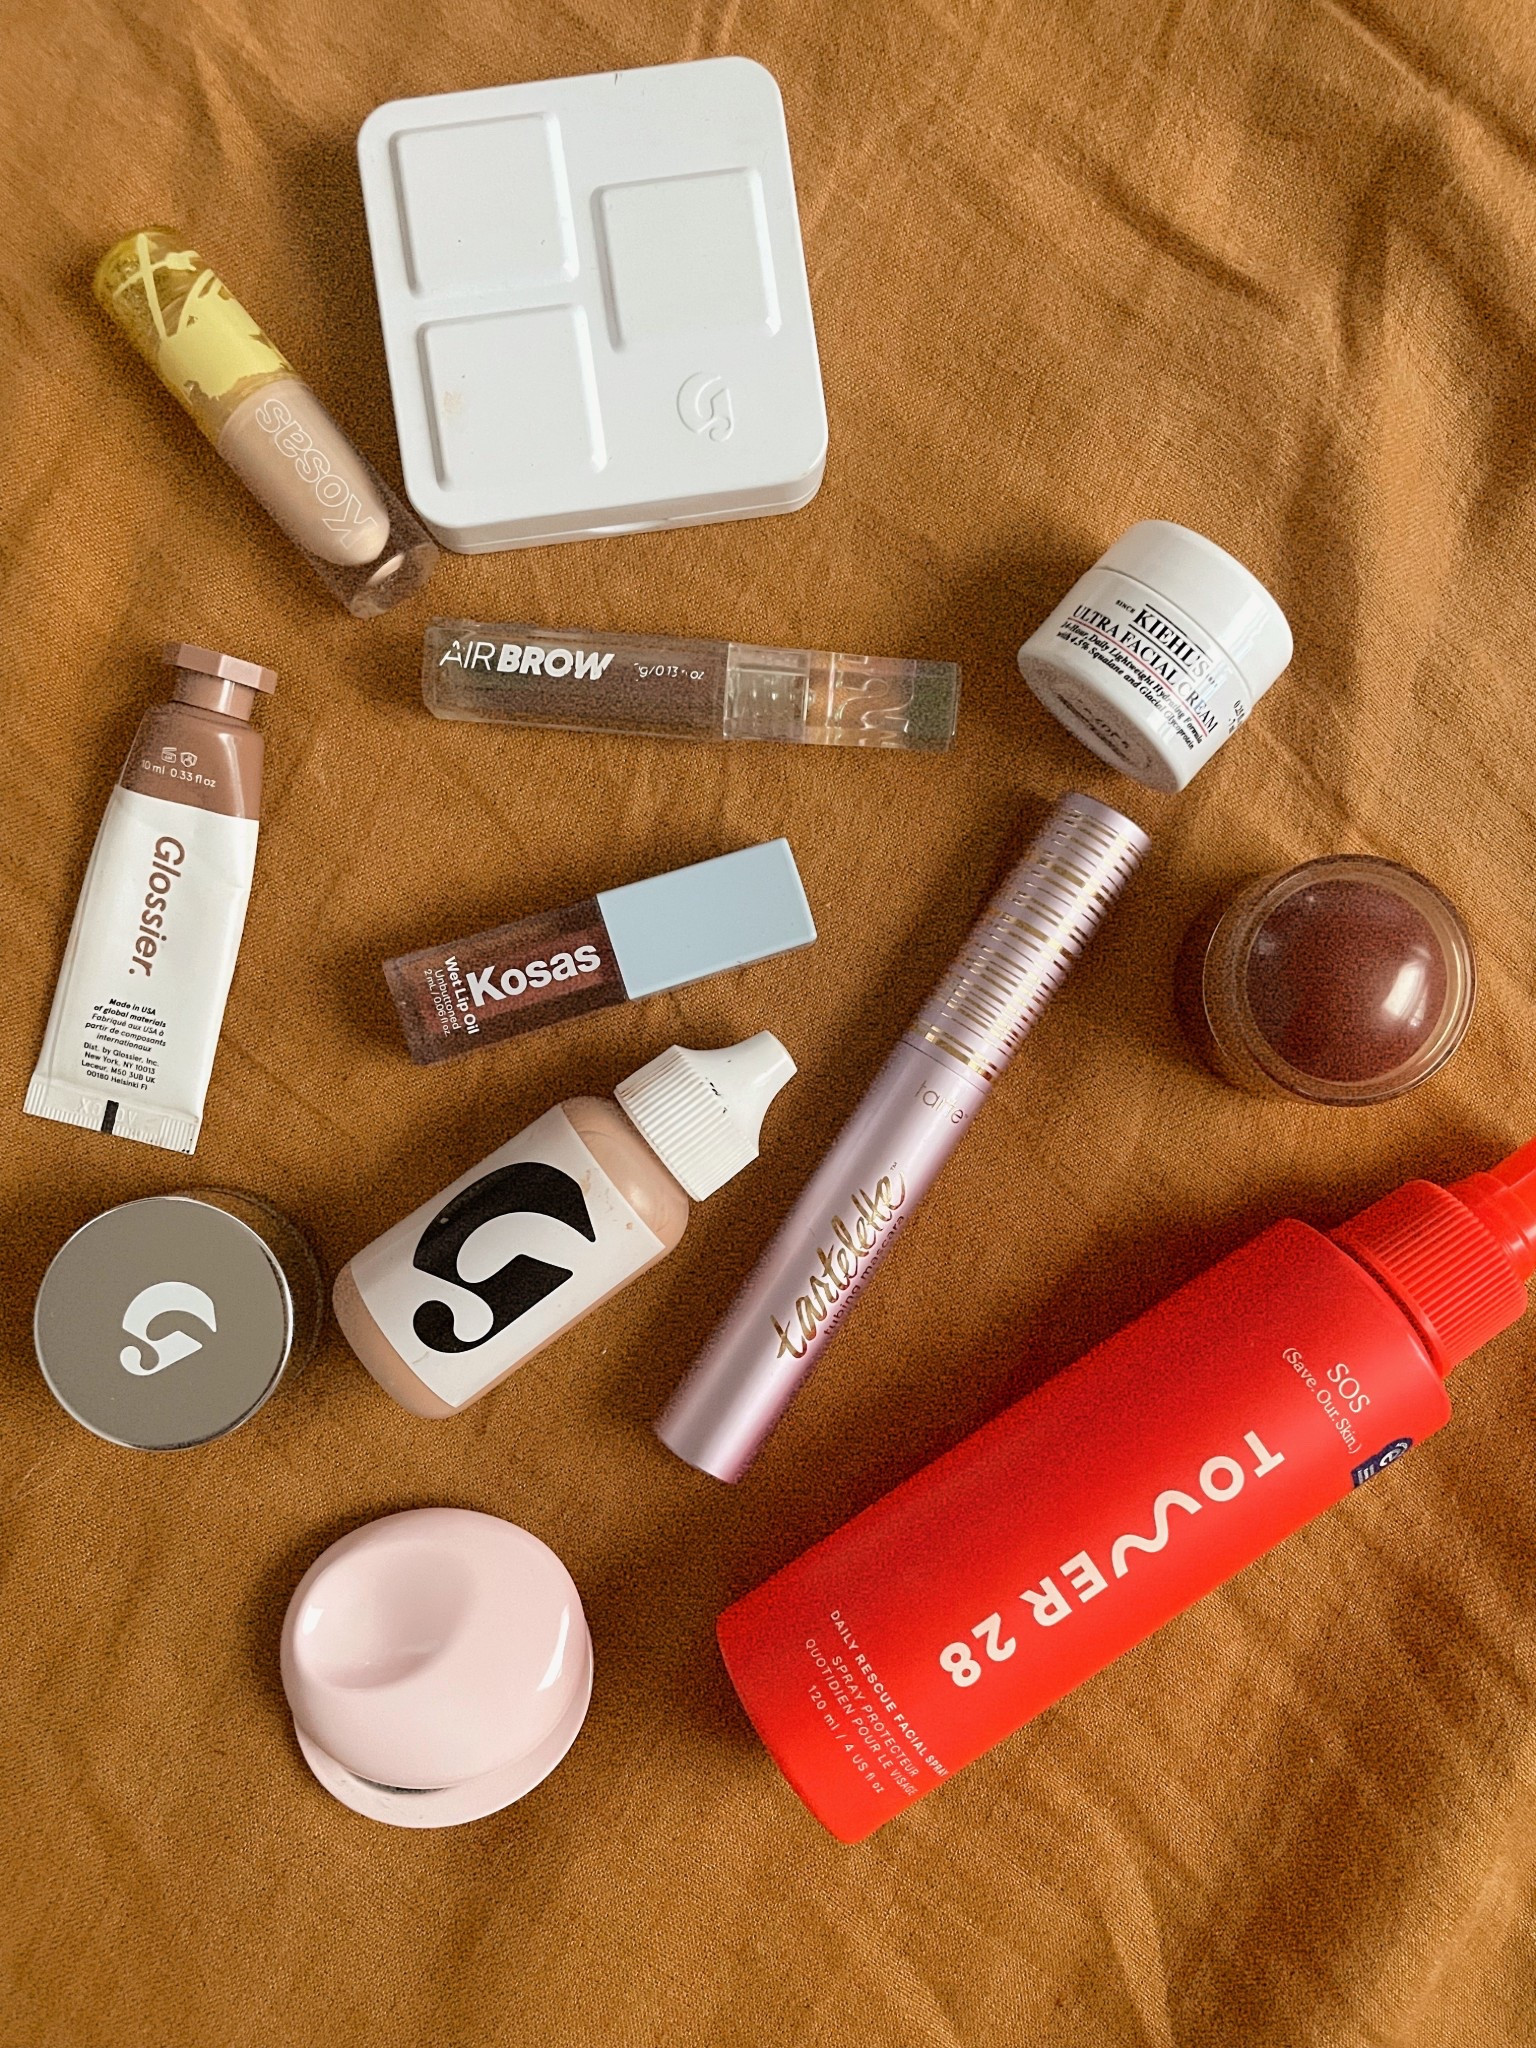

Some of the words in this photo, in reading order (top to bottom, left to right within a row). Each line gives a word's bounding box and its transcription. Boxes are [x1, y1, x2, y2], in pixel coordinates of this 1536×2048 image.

[255, 399, 378, 549] Kosas
[1073, 604, 1120, 638] ULTRA
[1120, 631, 1177, 685] FACIAL
[1177, 681, 1218, 733] CREAM
[1088, 633, 1110, 651] Daily
[1108, 647, 1155, 687] Lightweight
[1152, 683, 1185, 720] Hydrating
[1133, 608, 1210, 678] KIEHL'S
[1088, 647, 1124, 675] Squalane
[1123, 674, 1141, 689] and
[1139, 685, 1165, 713] Glacial
[1163, 709, 1195, 750] Glycoprotein
[152, 765, 166, 775] ml
[170, 768, 193, 782] 0.33
[195, 774, 203, 784] fl
[203, 779, 217, 788] oz
[129, 836, 185, 977] Glossier.
[109, 998, 131, 1009] Made
[132, 1003, 140, 1011] in
[141, 1006, 156, 1016] USA
[424, 968, 432, 976] 2
[443, 1024, 451, 1037] oz
[434, 969, 462, 1030] Unbuttoned
[444, 956, 462, 987] Wet
[455, 988, 469, 1012] Lip
[464, 1013, 480, 1035] Oil
[466, 944, 600, 1007] Kosas
[85, 1022, 108, 1032] partir
[121, 1031, 166, 1047] composants
[92, 1013, 127, 1027] Fabriqué
[128, 1023, 142, 1031] aux
[143, 1026, 157, 1035] USA
[96, 1033, 152, 1052] internationaux
[102, 1007, 129, 1018] global
[130, 1013, 166, 1028] materials
[83, 1042, 100, 1052] Dist.
[102, 1046, 111, 1055] by
[146, 1057, 160, 1067] Inc.
[85, 1051, 101, 1061] New
[123, 1061, 134, 1069] NY
[135, 1064, 156, 1075] 10013
[87, 1069, 109, 1081] 00180
[110, 1076, 139, 1089] Helsinki
[111, 1066, 127, 1076] M50
[145, 1076, 156, 1084] UK
[1282, 1347, 1317, 1392] (Save.
[1316, 1389, 1340, 1422] Our.
[1336, 1418, 1362, 1454] Skin.)
[1326, 1363, 1371, 1413] SOS
[1019, 1430, 1285, 1628] TOWER
[939, 1612, 1017, 1688] 28
[805, 1638, 855, 1715] QUOTIDIEN
[852, 1717, 881, 1753] POUR
[877, 1753, 894, 1769] LE
[890, 1768, 919, 1796] VISAGE
[830, 1610, 859, 1650] DAILY
[855, 1653, 897, 1713] RESCUE
[893, 1713, 928, 1757] FACIAL
[925, 1755, 949, 1777] SPRAY
[832, 1656, 866, 1700] SPRAY
[861, 1704, 919, 1777] PROTECTEUR
[808, 1684, 827, 1710] 120
[823, 1713, 840, 1732] ml
[844, 1744, 855, 1752] 4
[852, 1753, 869, 1772] US
[865, 1772, 876, 1781] fl
[872, 1782, 885, 1794] oz
